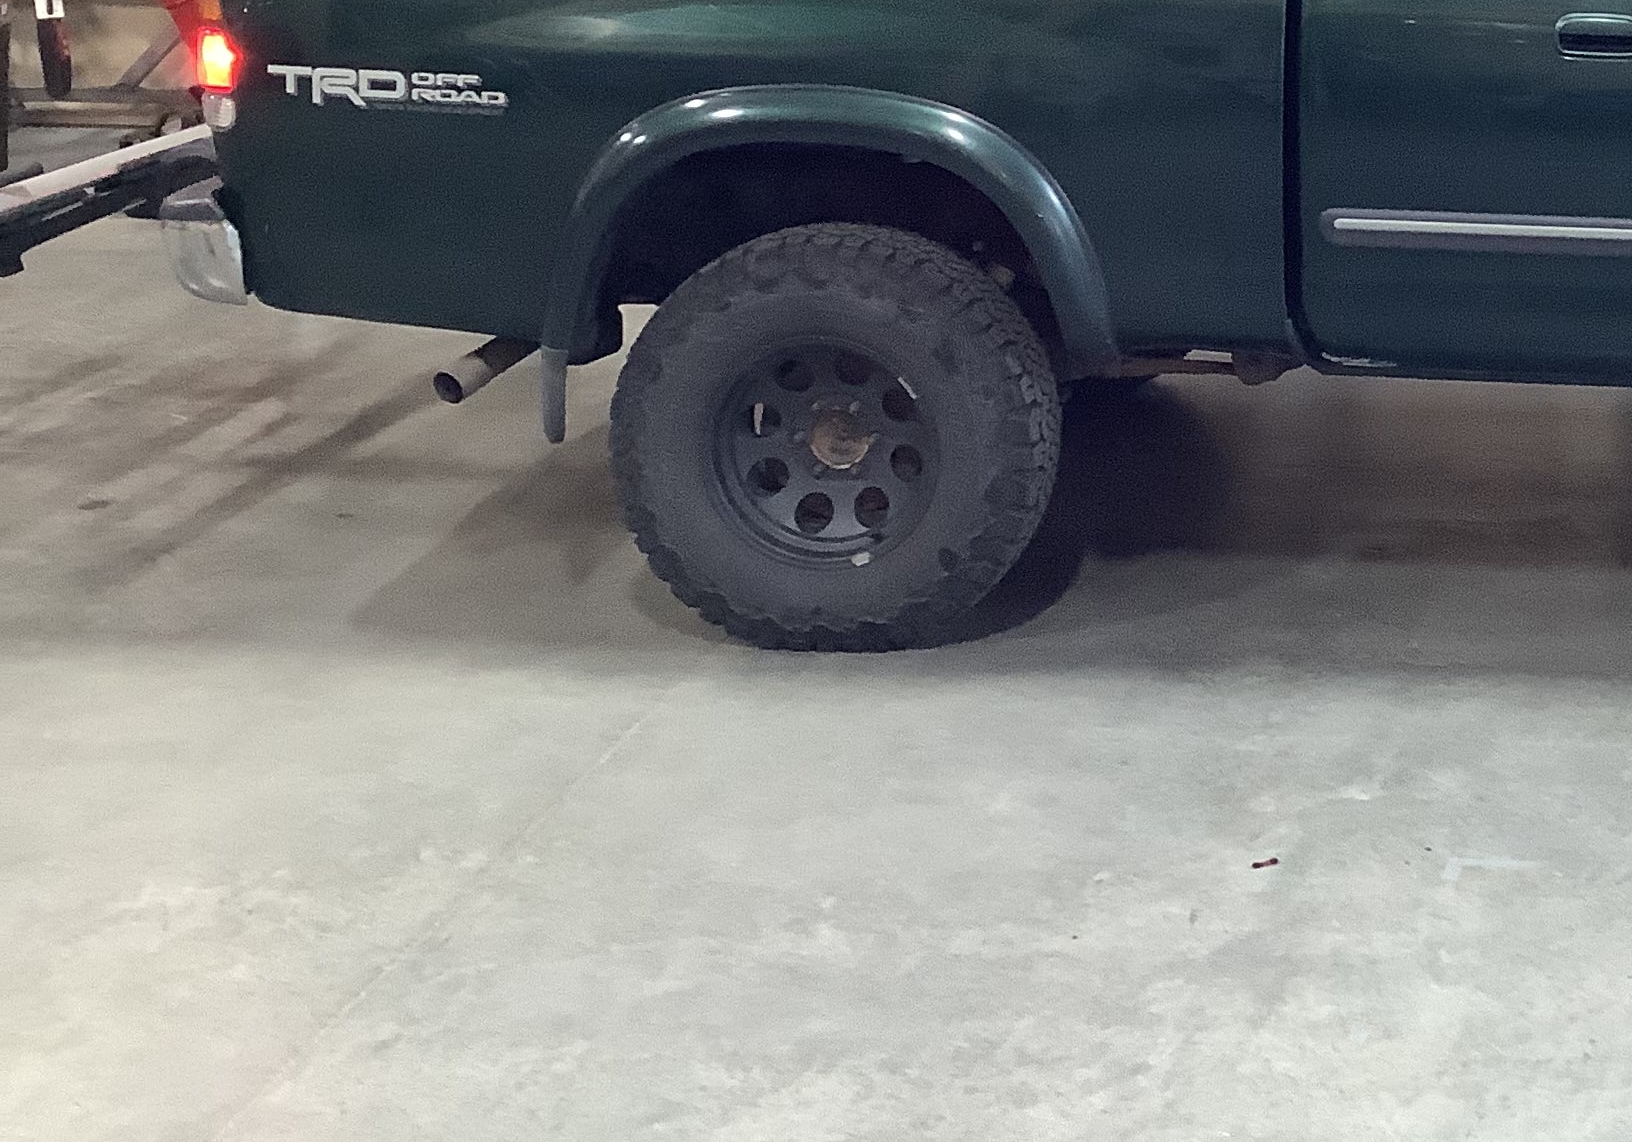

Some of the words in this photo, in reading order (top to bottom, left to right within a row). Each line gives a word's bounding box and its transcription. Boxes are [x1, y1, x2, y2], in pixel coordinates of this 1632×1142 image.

[266, 63, 407, 107] TRD
[410, 71, 483, 88] OFF
[410, 87, 509, 107] ROAD
